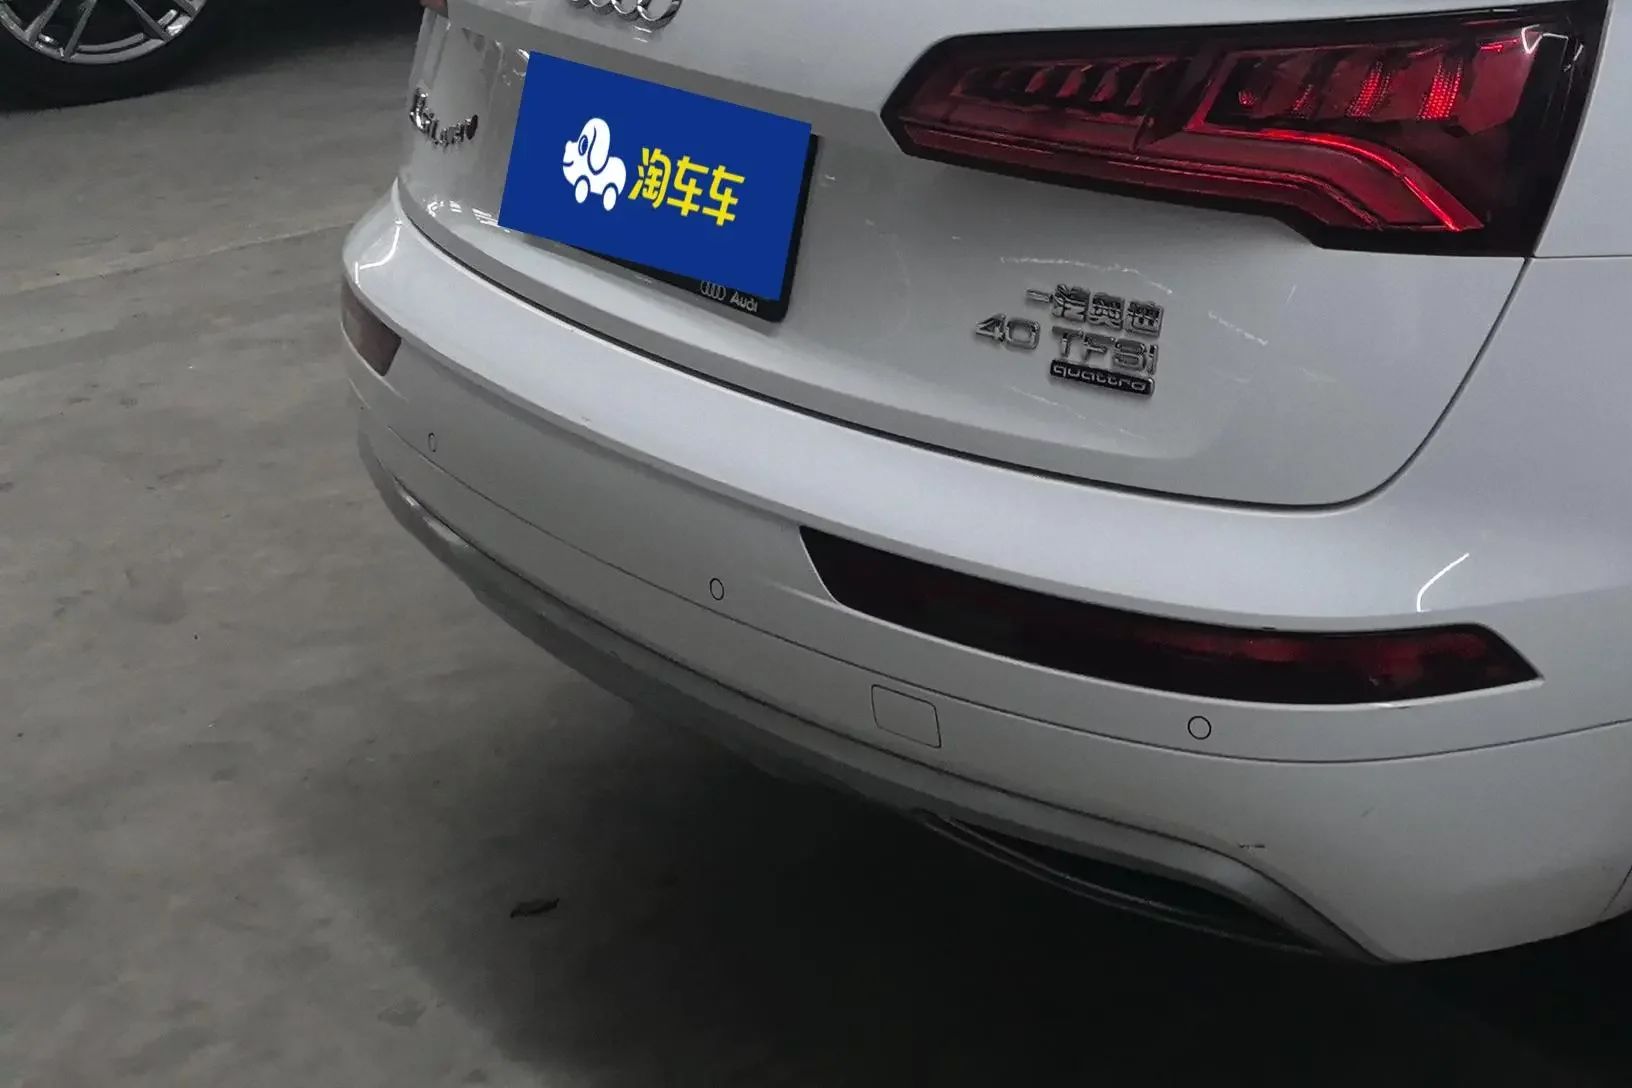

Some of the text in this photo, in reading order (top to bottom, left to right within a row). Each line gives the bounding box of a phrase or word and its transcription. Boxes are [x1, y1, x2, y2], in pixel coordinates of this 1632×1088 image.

[730, 290, 758, 312] Audi
[974, 312, 1159, 377] 40 TFSI
[1051, 363, 1148, 392] quattro
